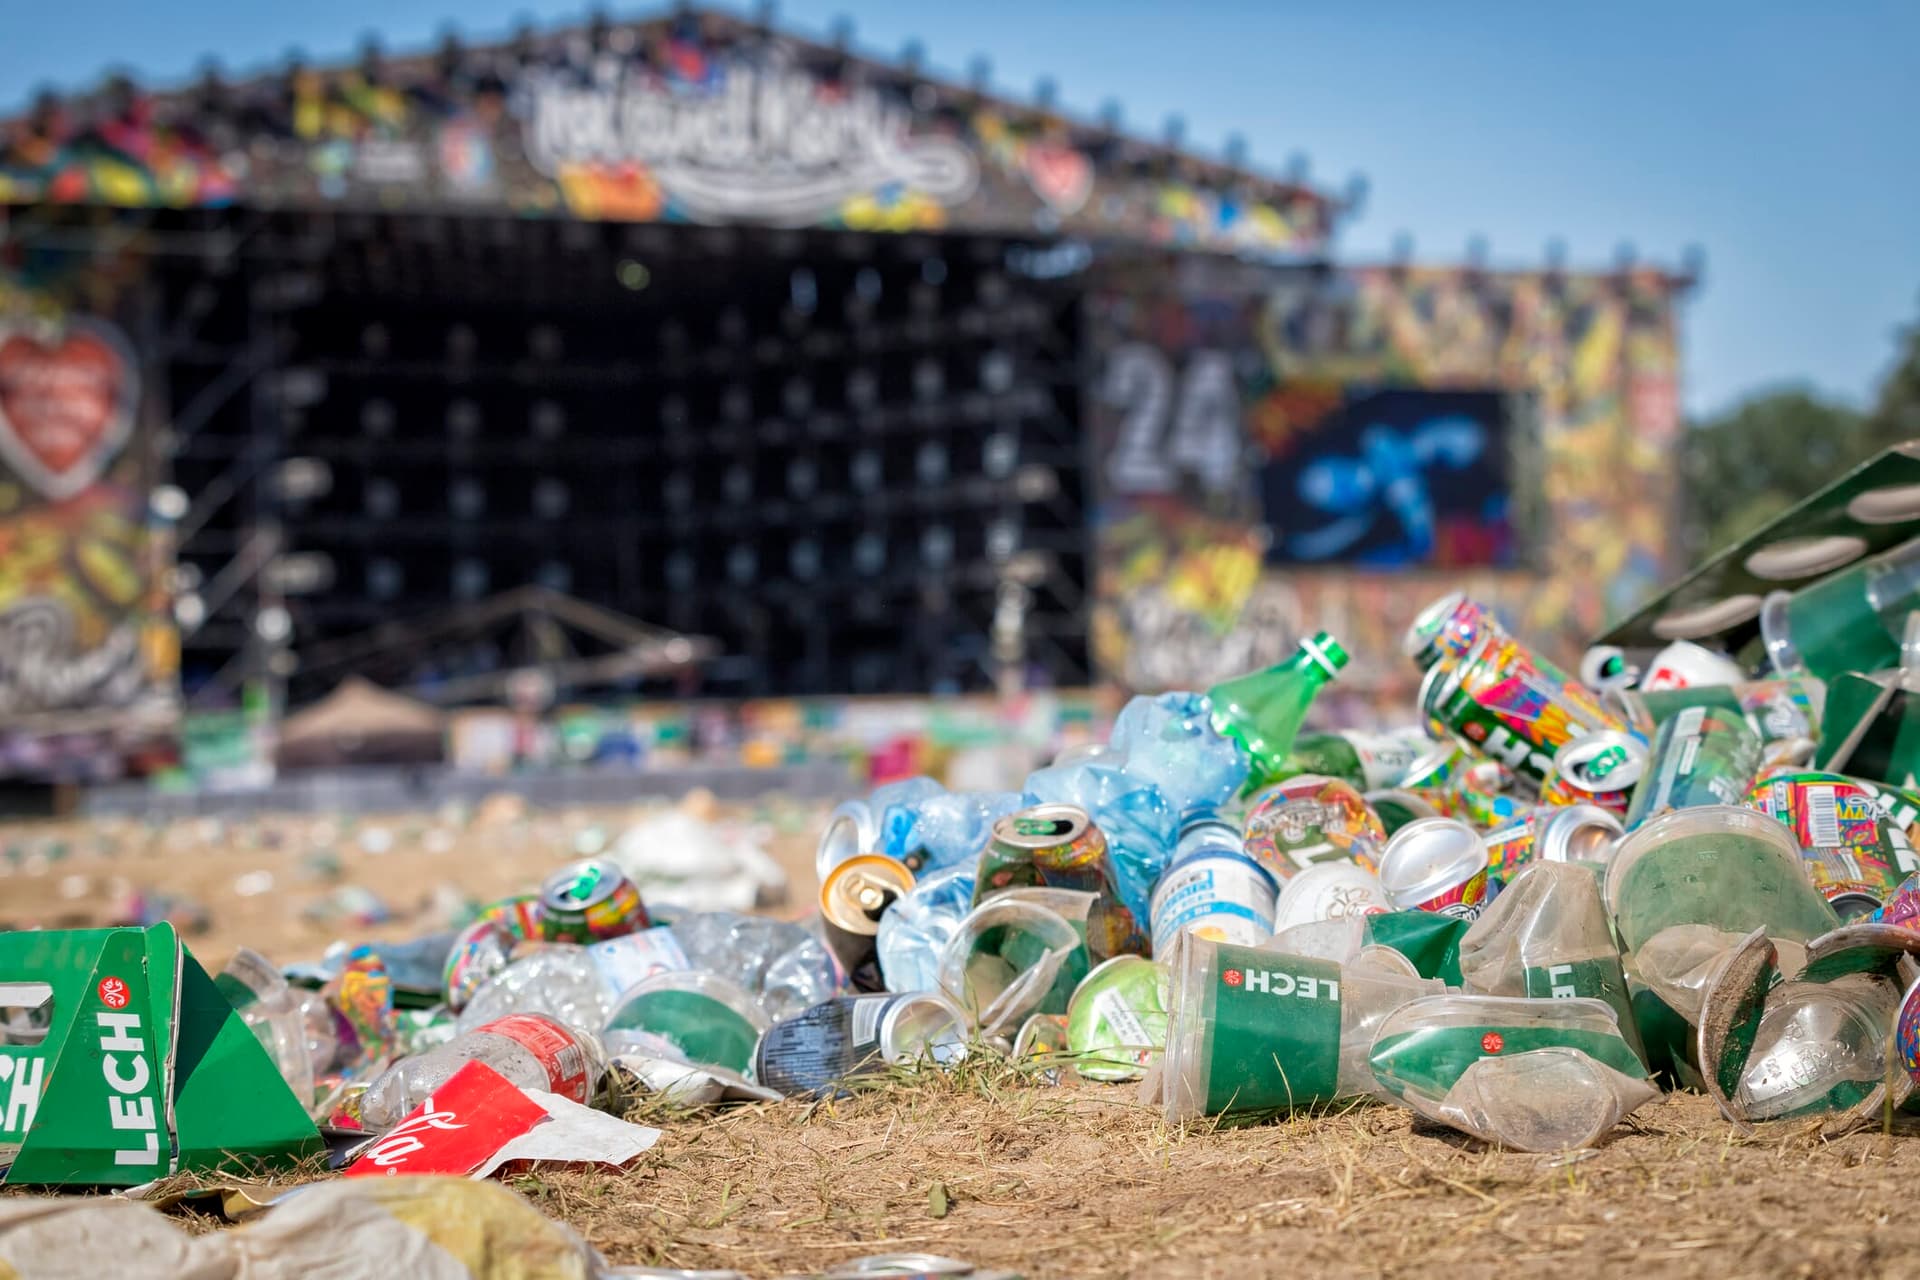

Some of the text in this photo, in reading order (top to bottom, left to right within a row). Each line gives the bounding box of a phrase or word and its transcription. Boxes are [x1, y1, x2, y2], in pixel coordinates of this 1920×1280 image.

[1103, 345, 1241, 491] 24
[1245, 968, 1339, 1001] LECH
[97, 1012, 160, 1165] LECH
